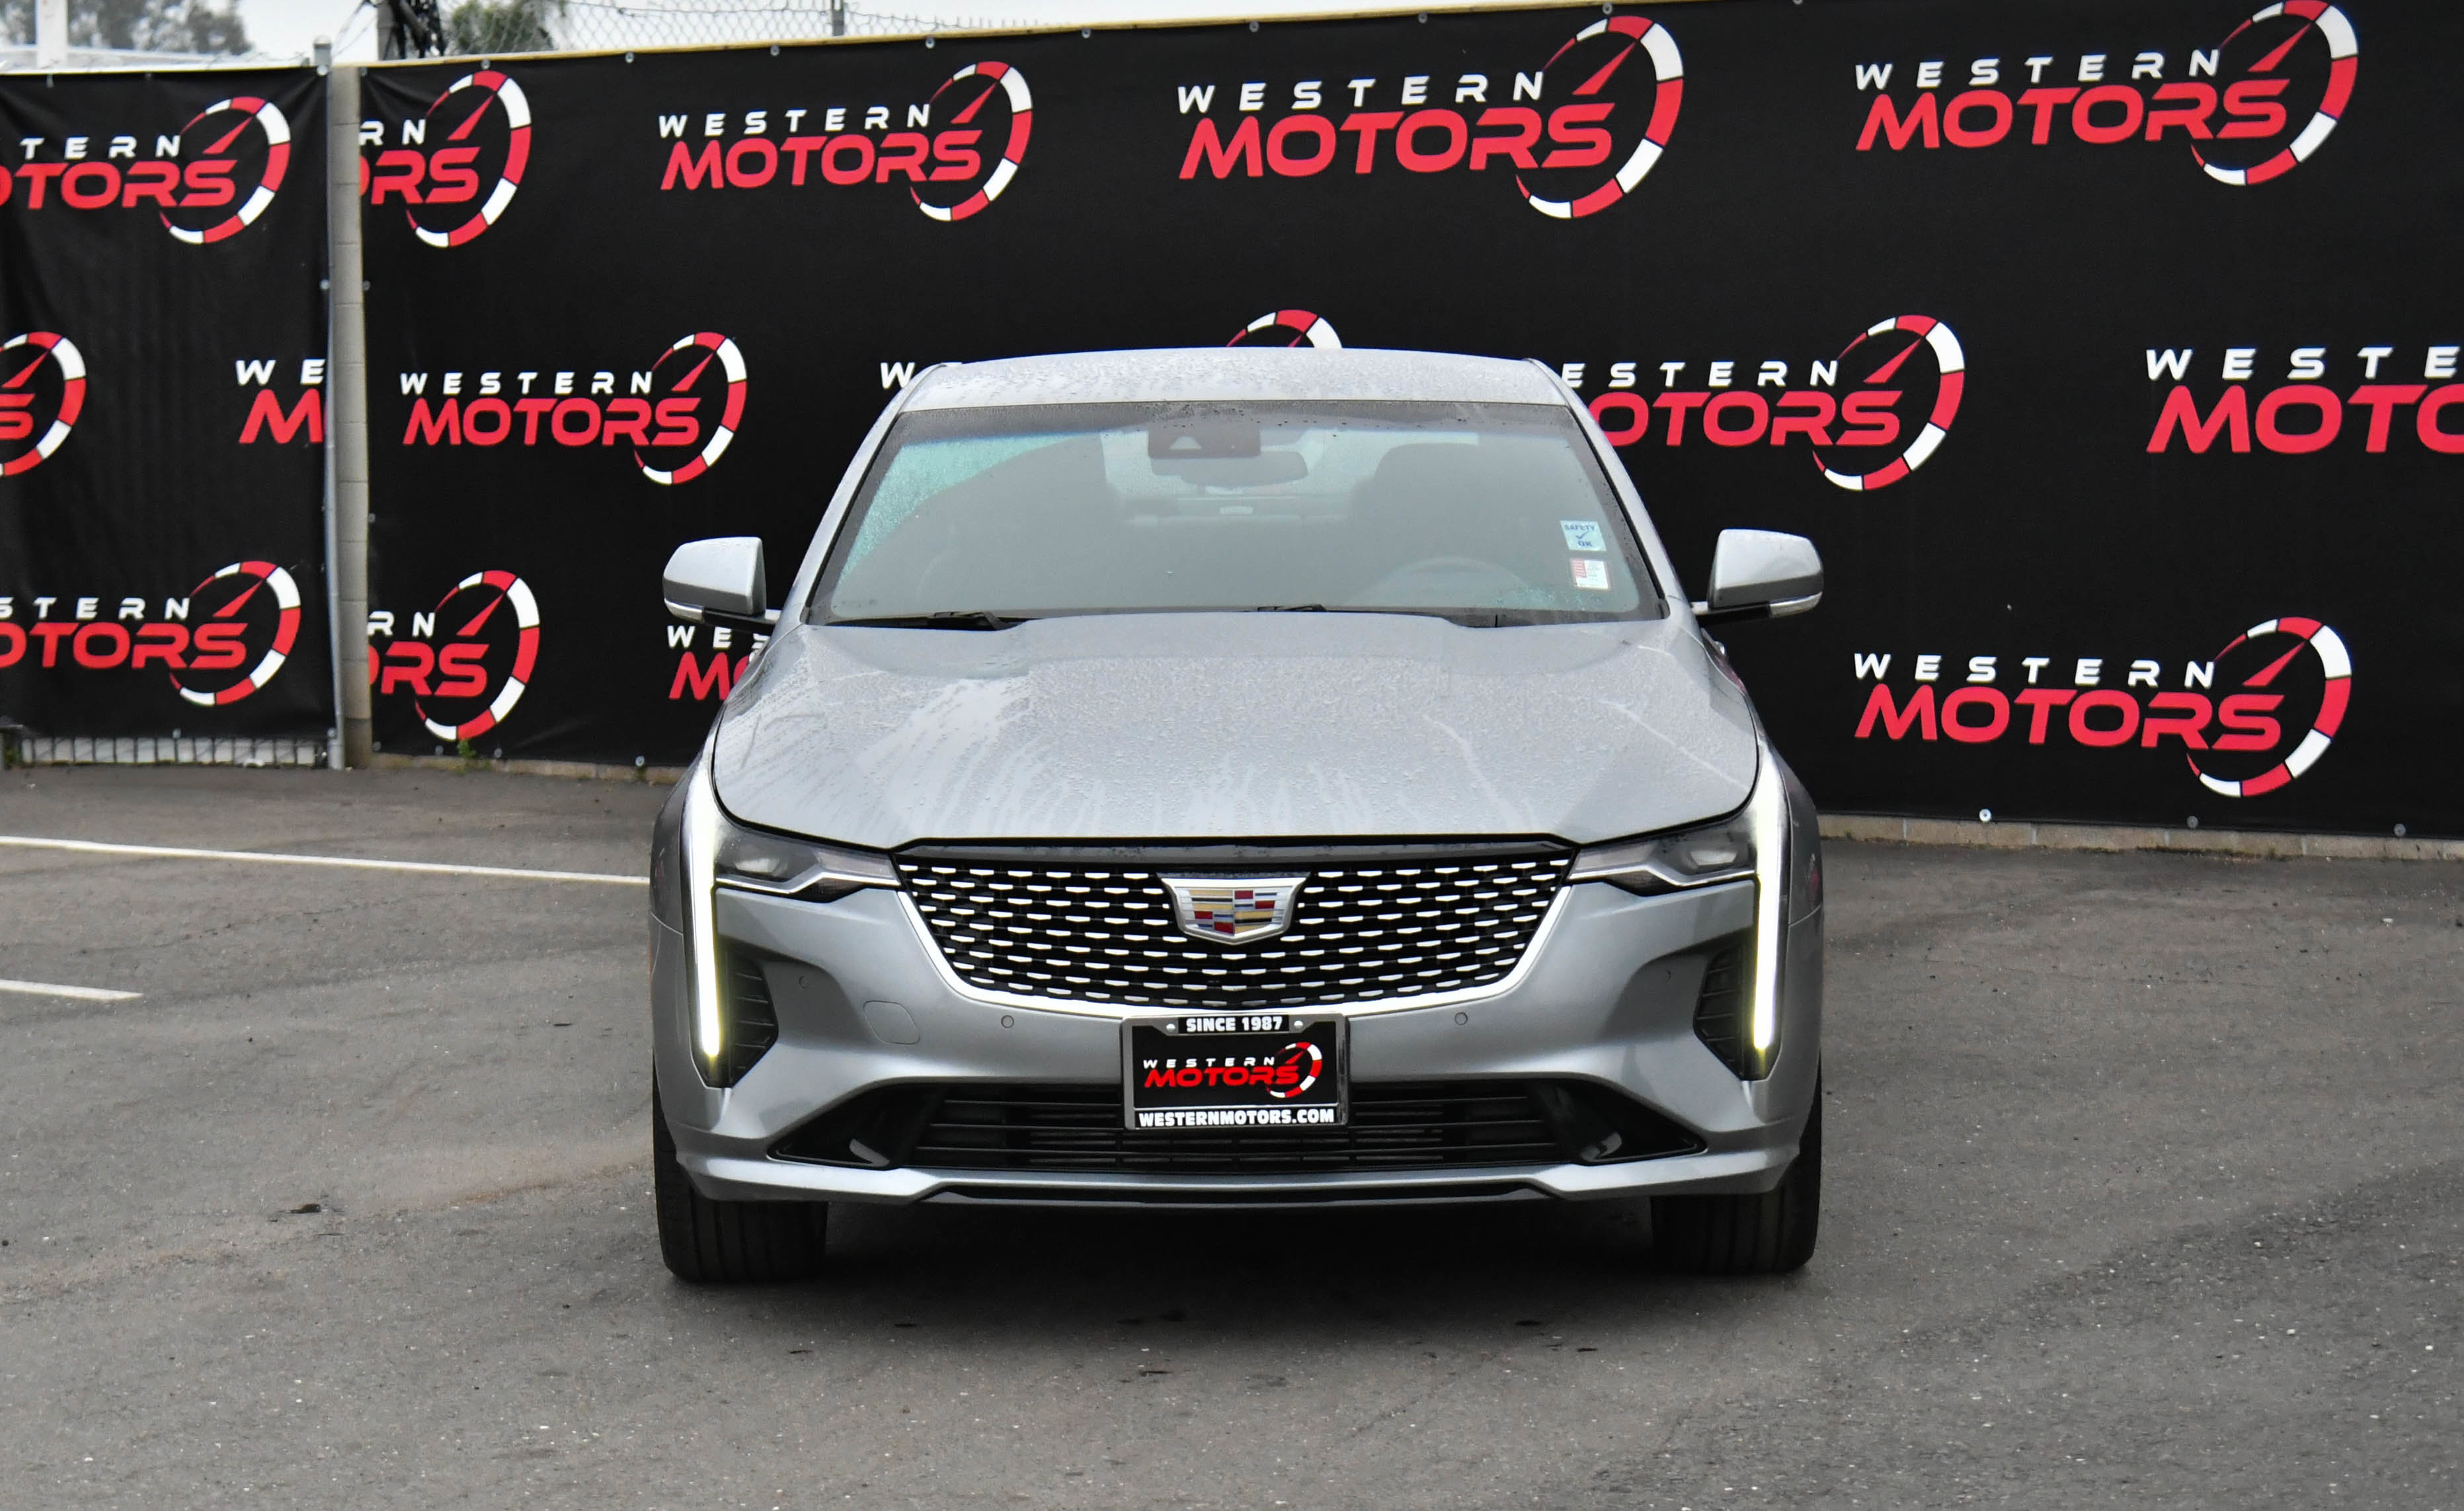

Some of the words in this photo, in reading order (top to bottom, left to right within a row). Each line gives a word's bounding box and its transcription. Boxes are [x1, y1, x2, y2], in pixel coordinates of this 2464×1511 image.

[1856, 50, 2219, 89] WESTERN
[1178, 71, 1543, 113] WESTERN
[659, 104, 930, 138] WESTERN
[1856, 79, 2289, 151] MOTORS
[661, 130, 983, 190] MOTORS
[1179, 102, 1615, 180] MOTORS
[0, 159, 237, 210] TORS
[360, 146, 481, 205] RS
[2146, 345, 2461, 380] WESTE
[400, 371, 652, 395] WESTERN
[403, 397, 701, 446] MOTORS
[368, 641, 490, 698] RS
[1854, 652, 2215, 688] WESTERN
[1854, 684, 2284, 751] MOTORS
[1186, 1017, 1236, 1032] SINCE
[1242, 1016, 1283, 1031] 1987
[1143, 1057, 1275, 1069] WESTERN
[1144, 1065, 1300, 1088] MOTORS
[1139, 1109, 1335, 1127] WESTERNMOTORS.COM
